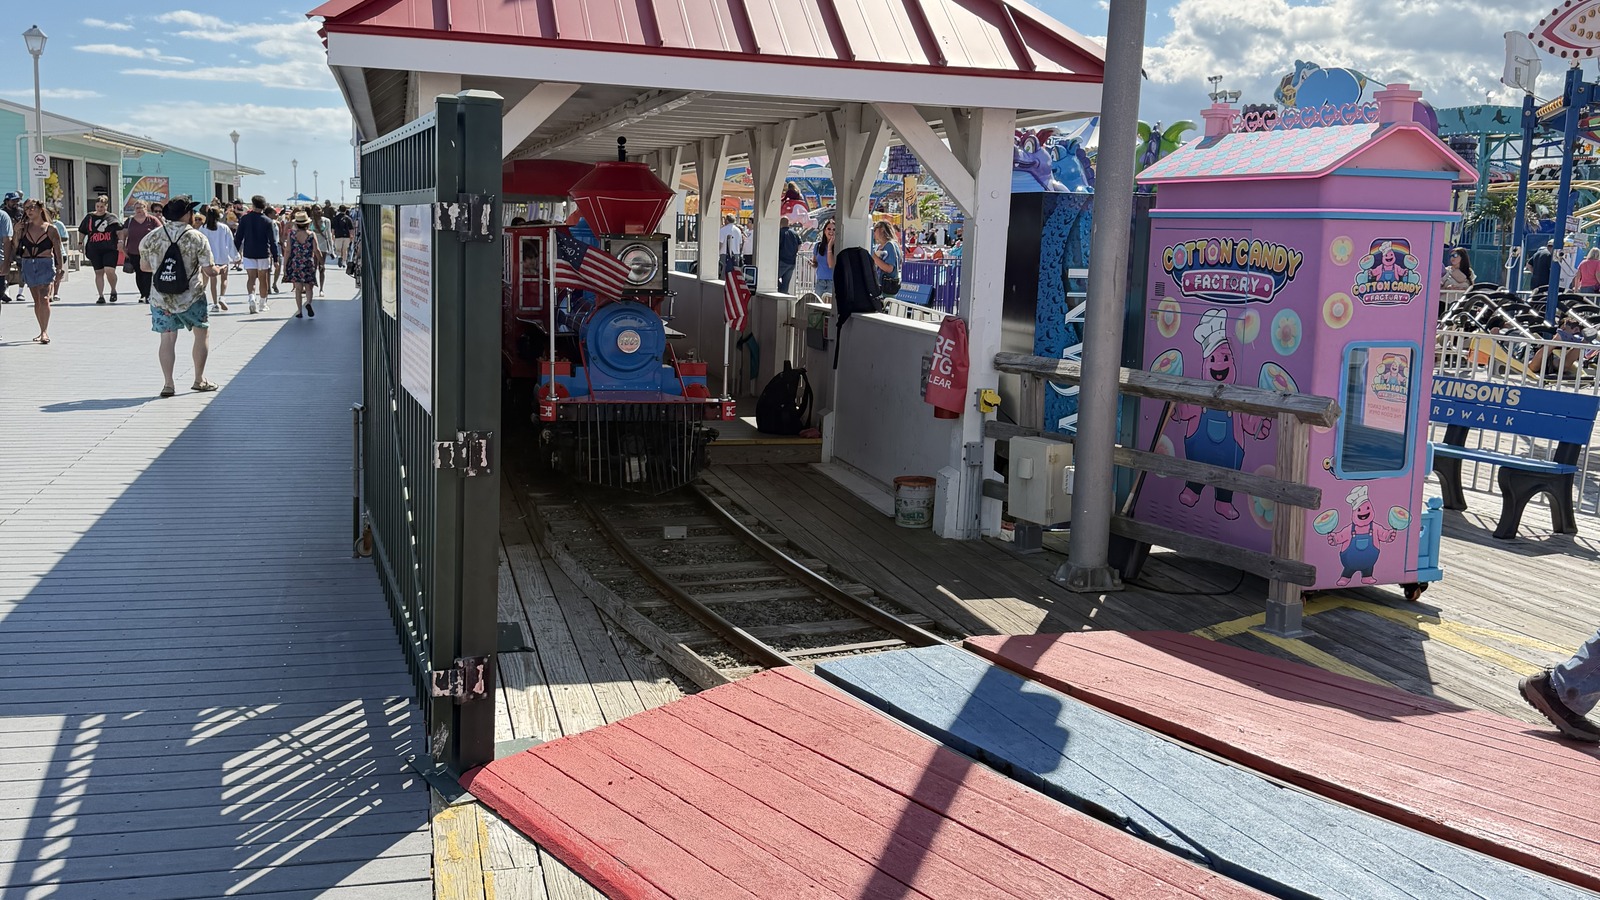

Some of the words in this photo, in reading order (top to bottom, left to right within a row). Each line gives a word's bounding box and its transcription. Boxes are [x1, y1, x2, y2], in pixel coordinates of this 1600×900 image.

[1163, 239, 1233, 272] COTTON
[1235, 239, 1302, 278] CANDY
[1194, 274, 1260, 293] FACTORY
[1352, 281, 1390, 295] COTTON
[1391, 280, 1422, 294] CANDY
[935, 335, 956, 358] RE
[930, 353, 955, 378] TG.
[928, 374, 952, 389] LEAR
[1432, 379, 1521, 406] KINSON'S
[1433, 405, 1514, 426] RDWALK
